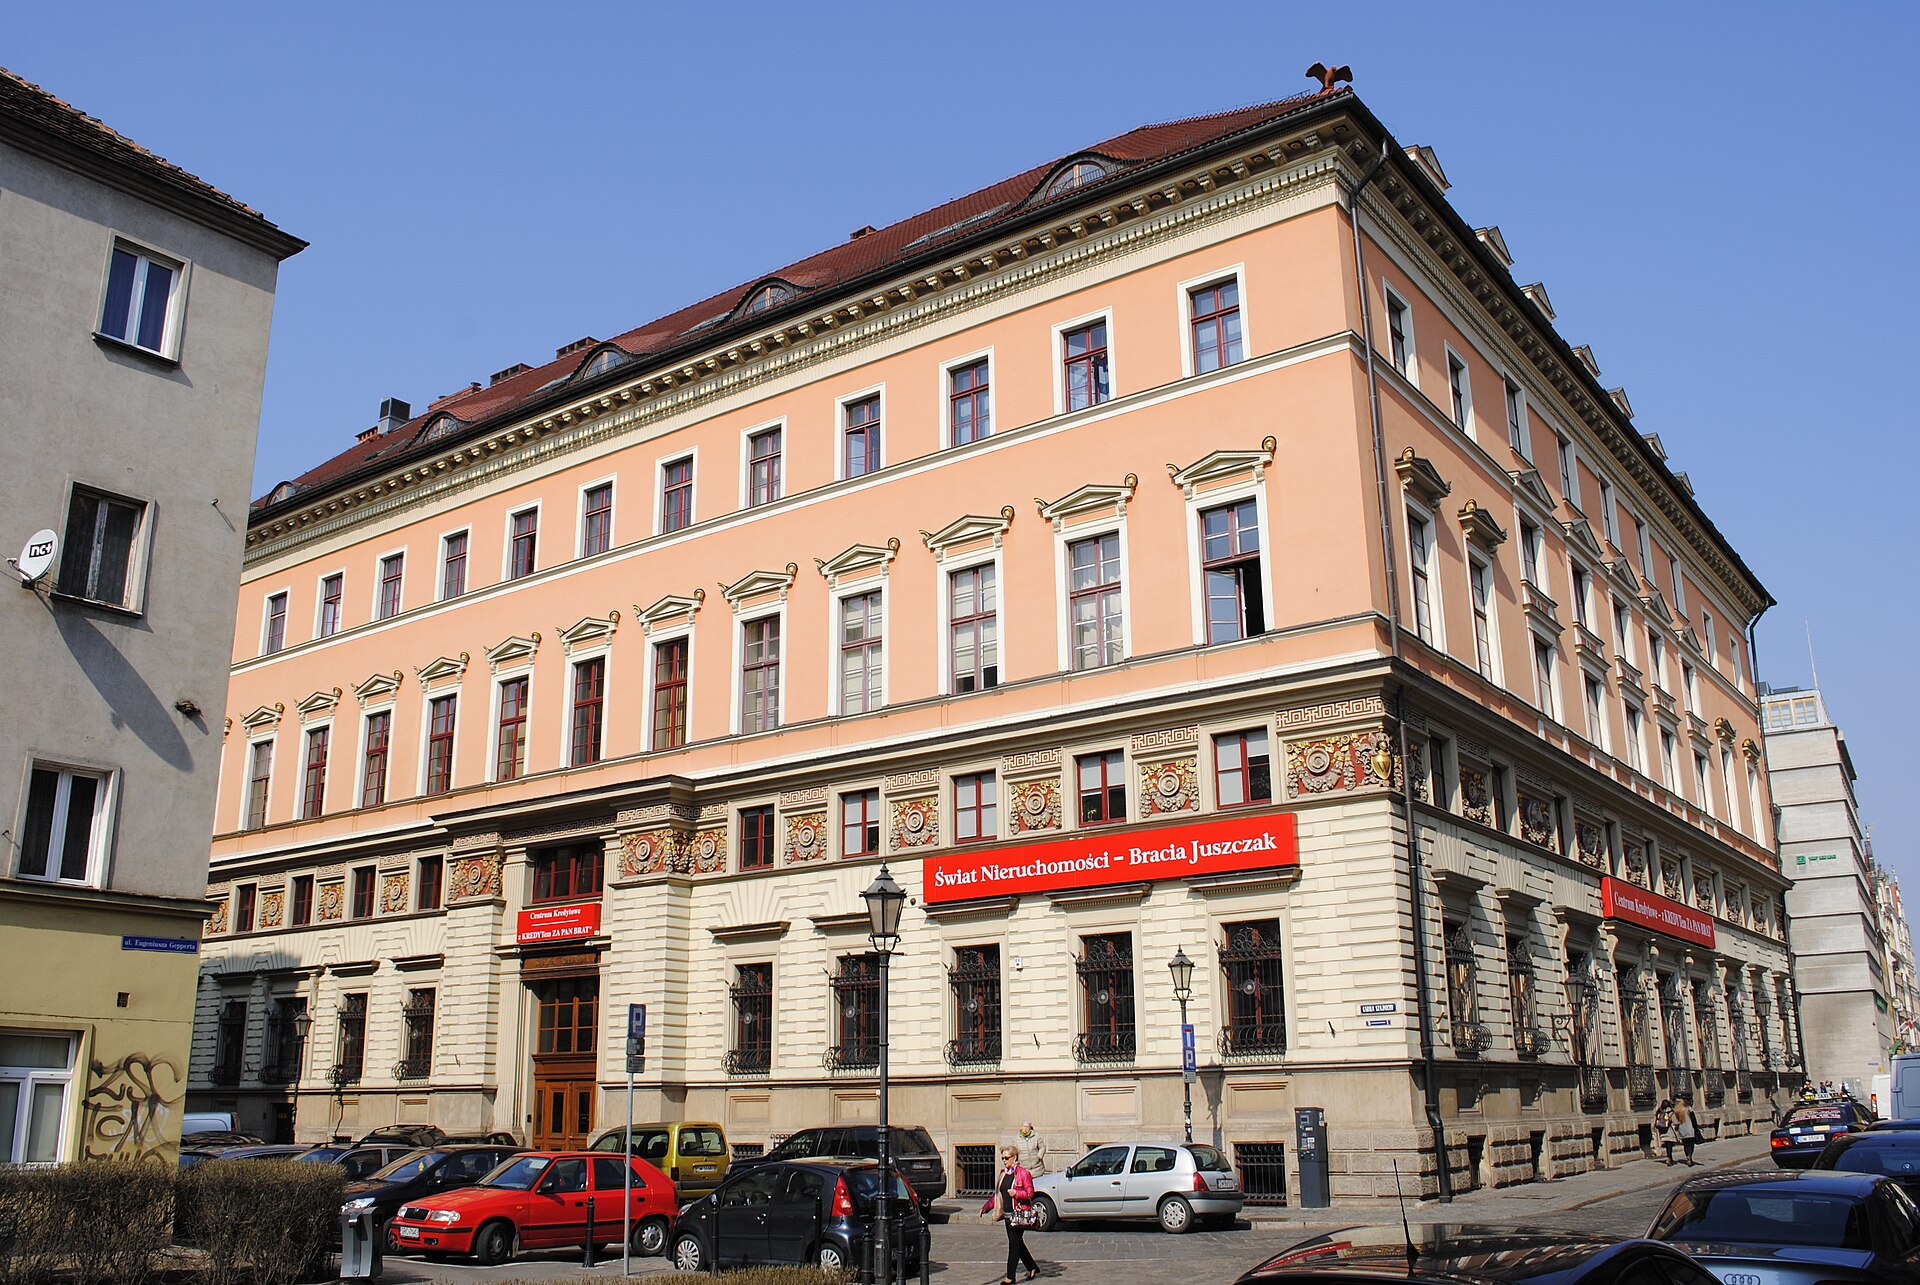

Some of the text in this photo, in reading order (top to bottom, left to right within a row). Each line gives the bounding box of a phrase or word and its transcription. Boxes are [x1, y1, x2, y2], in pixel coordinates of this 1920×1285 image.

[31, 543, 52, 557] nc+
[934, 865, 978, 887] Świat
[980, 851, 1110, 882] Nieruchomości
[1128, 843, 1187, 866] Bracia
[1188, 832, 1278, 864] Juszczak
[529, 908, 581, 920] Centrum Kredytowe
[552, 929, 560, 937] ZA
[561, 927, 573, 936] PAN
[124, 938, 132, 946] ul.
[169, 941, 196, 950] Gepperta
[632, 1007, 643, 1033] P
